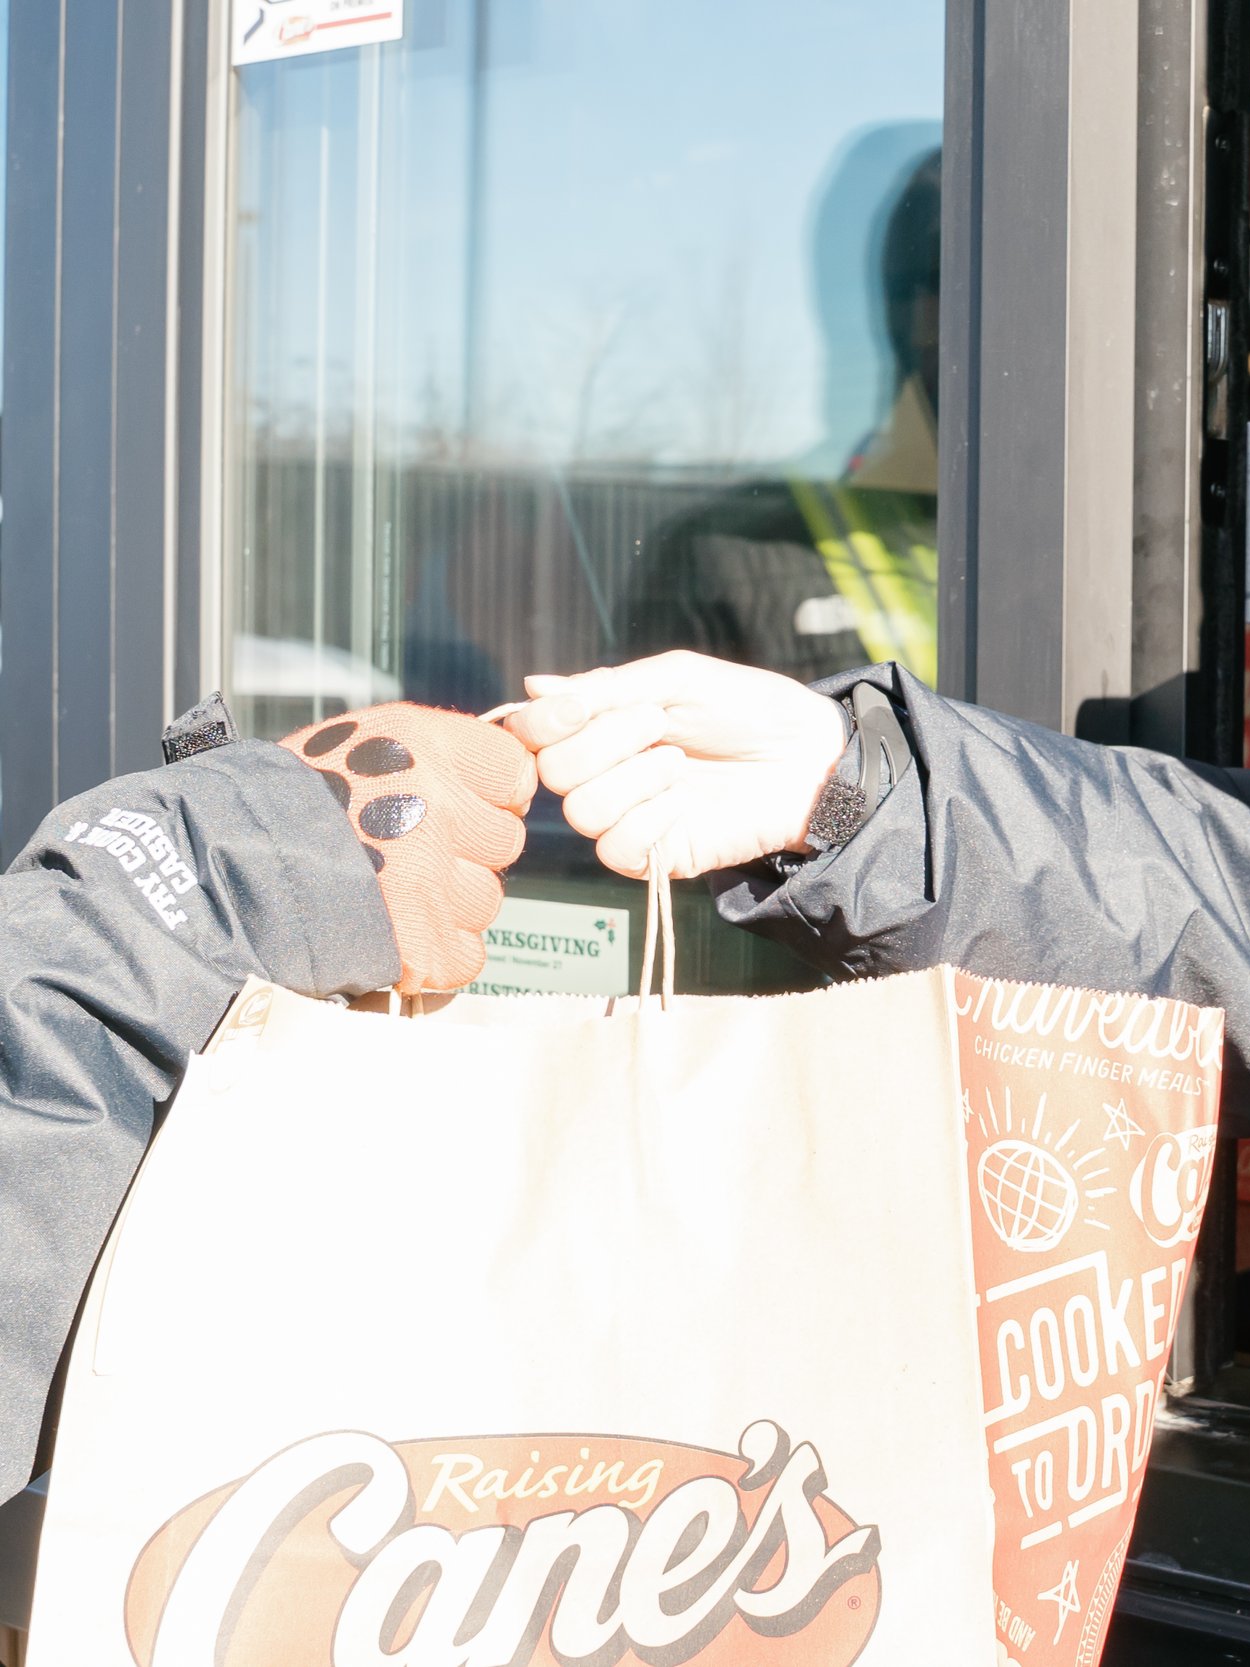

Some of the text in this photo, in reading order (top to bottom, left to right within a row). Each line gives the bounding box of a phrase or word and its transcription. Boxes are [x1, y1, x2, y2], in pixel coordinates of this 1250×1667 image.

[100, 808, 198, 894] CASHIER
[133, 872, 188, 930] FRY
[481, 928, 601, 957] NKSGIVING
[974, 1035, 1204, 1096] CHICKEN FINGER MEALS
[997, 1250, 1186, 1418] COOKED
[1012, 1366, 1166, 1518] TO ORD
[421, 1449, 665, 1511] Raising
[150, 1419, 882, 1667] Cane's
